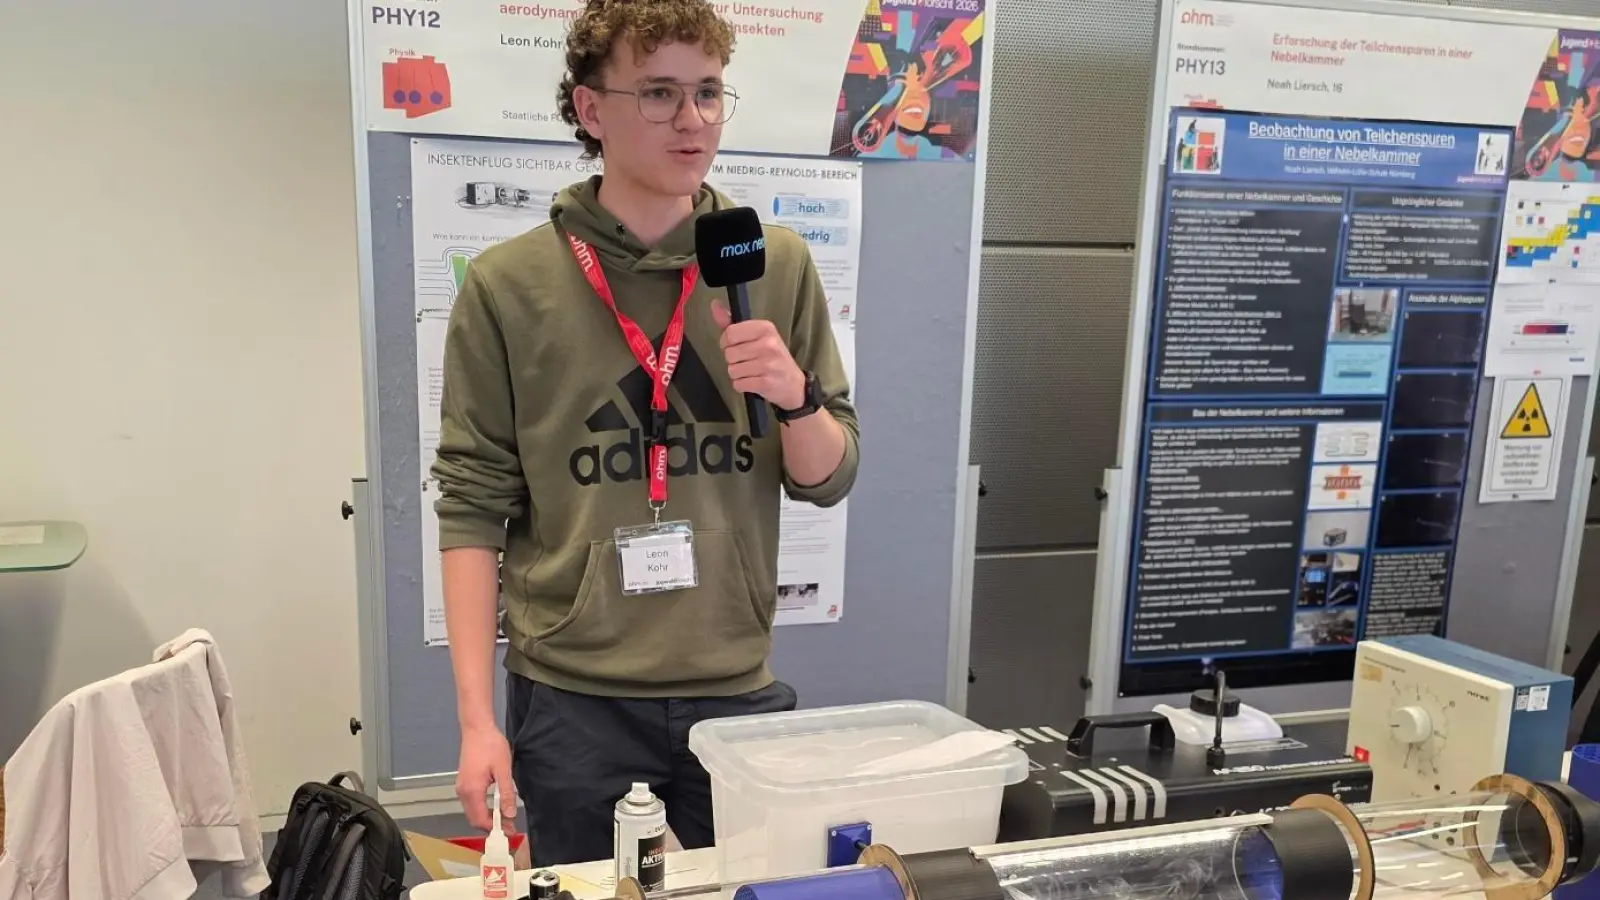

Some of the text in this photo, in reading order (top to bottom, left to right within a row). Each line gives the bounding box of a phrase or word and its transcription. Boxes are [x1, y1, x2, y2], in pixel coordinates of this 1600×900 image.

[372, 6, 441, 28] PHY12
[500, 4, 581, 19] aerodynam
[733, 3, 823, 23] Untersuchung
[500, 33, 530, 47] Leon
[1273, 33, 1473, 59] Erforschung der Teilchenspuren in einer
[389, 48, 416, 56] Physik
[1271, 51, 1345, 66] Nebelkammer
[1176, 57, 1226, 76] PHY13
[1267, 79, 1291, 90] Noah
[502, 110, 548, 121] Staatliche
[1249, 121, 1456, 148] Beobachtung von Teilchenspuren
[1284, 144, 1421, 165] in einer Nebelkammer
[428, 153, 604, 174] INSEKTENFLUG SICHTBAR GEM
[712, 164, 857, 180] IM NIEDRIG-REYNOLDS-BEREICH
[798, 203, 825, 213] hoch
[660, 345, 679, 387] ohm
[656, 448, 666, 481] ohm
[646, 549, 669, 559] Leon
[647, 563, 669, 573] Kohr
[641, 853, 665, 866] AKTI
